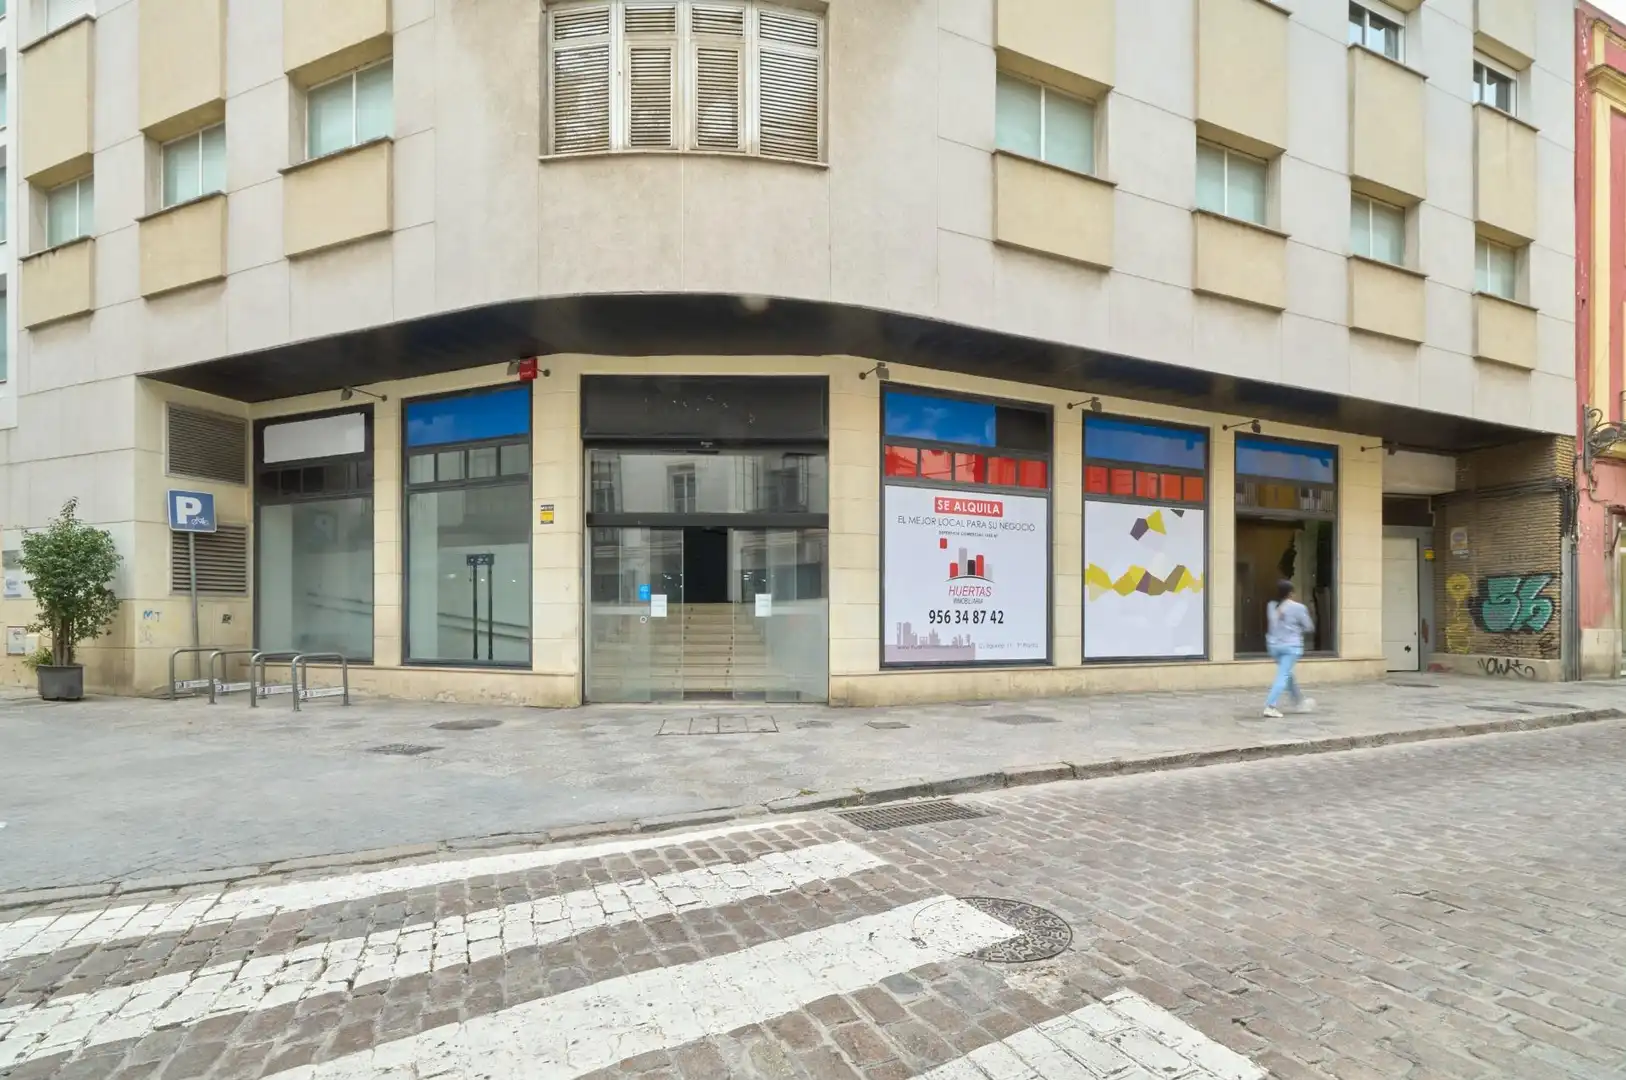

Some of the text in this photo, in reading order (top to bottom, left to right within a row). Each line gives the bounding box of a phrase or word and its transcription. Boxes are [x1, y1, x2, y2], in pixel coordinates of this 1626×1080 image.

[176, 496, 202, 524] P
[937, 500, 1000, 515] SE ALQUILA
[897, 515, 1036, 532] EL MEJOR LOCAL PARA SU NEGOCIO
[948, 585, 992, 597] HUERTAS
[929, 610, 1004, 624] 956 34 87 42
